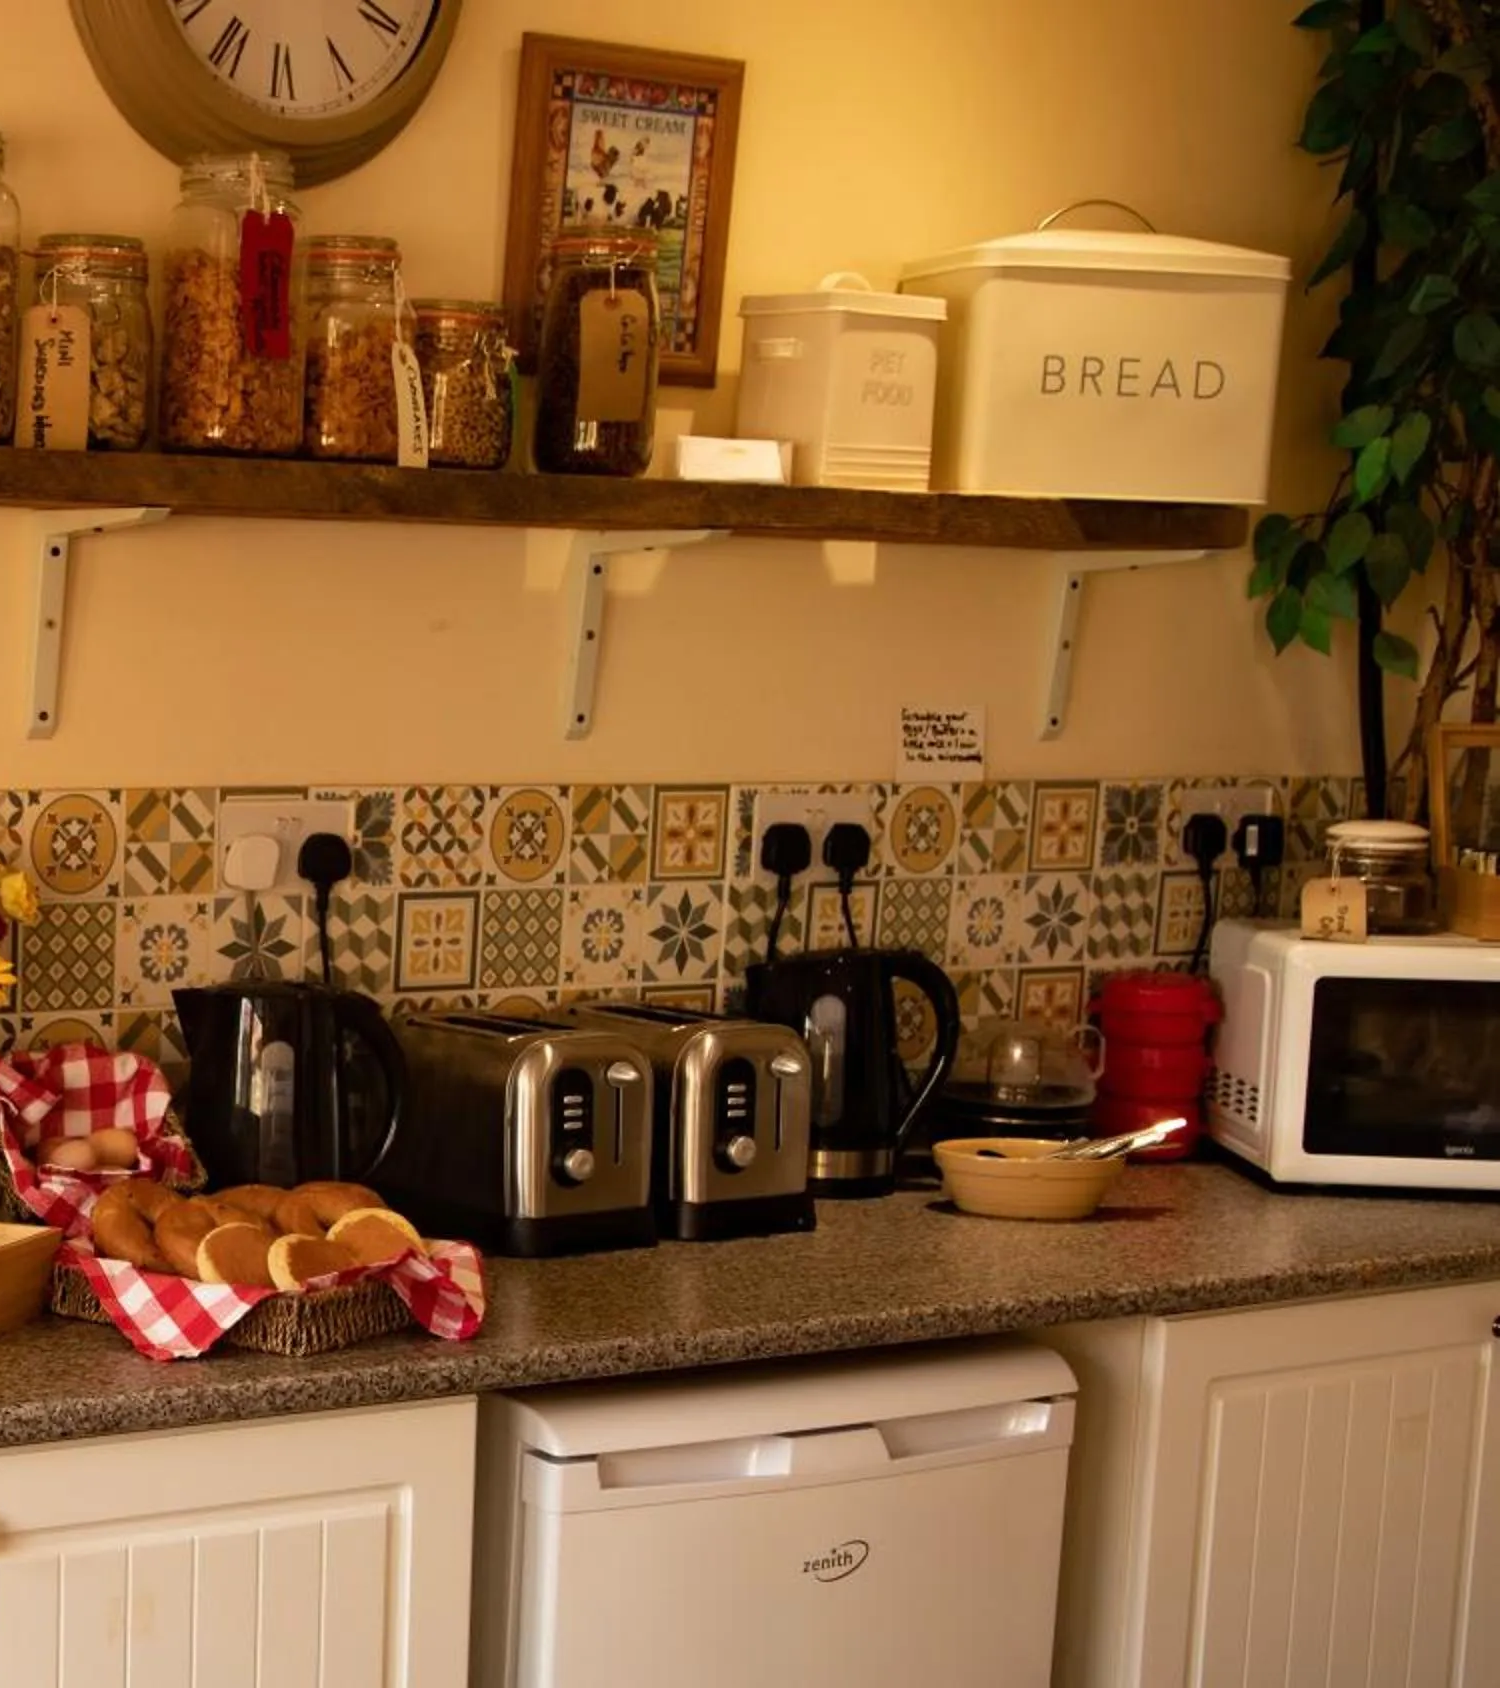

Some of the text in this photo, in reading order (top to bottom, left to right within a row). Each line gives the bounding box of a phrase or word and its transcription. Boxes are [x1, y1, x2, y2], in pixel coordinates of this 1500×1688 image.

[579, 108, 687, 135] SWEET CREAM
[869, 349, 906, 375] PET
[1039, 353, 1227, 401] BREAD
[861, 379, 913, 408] FOOD
[803, 1549, 852, 1573] zenith
